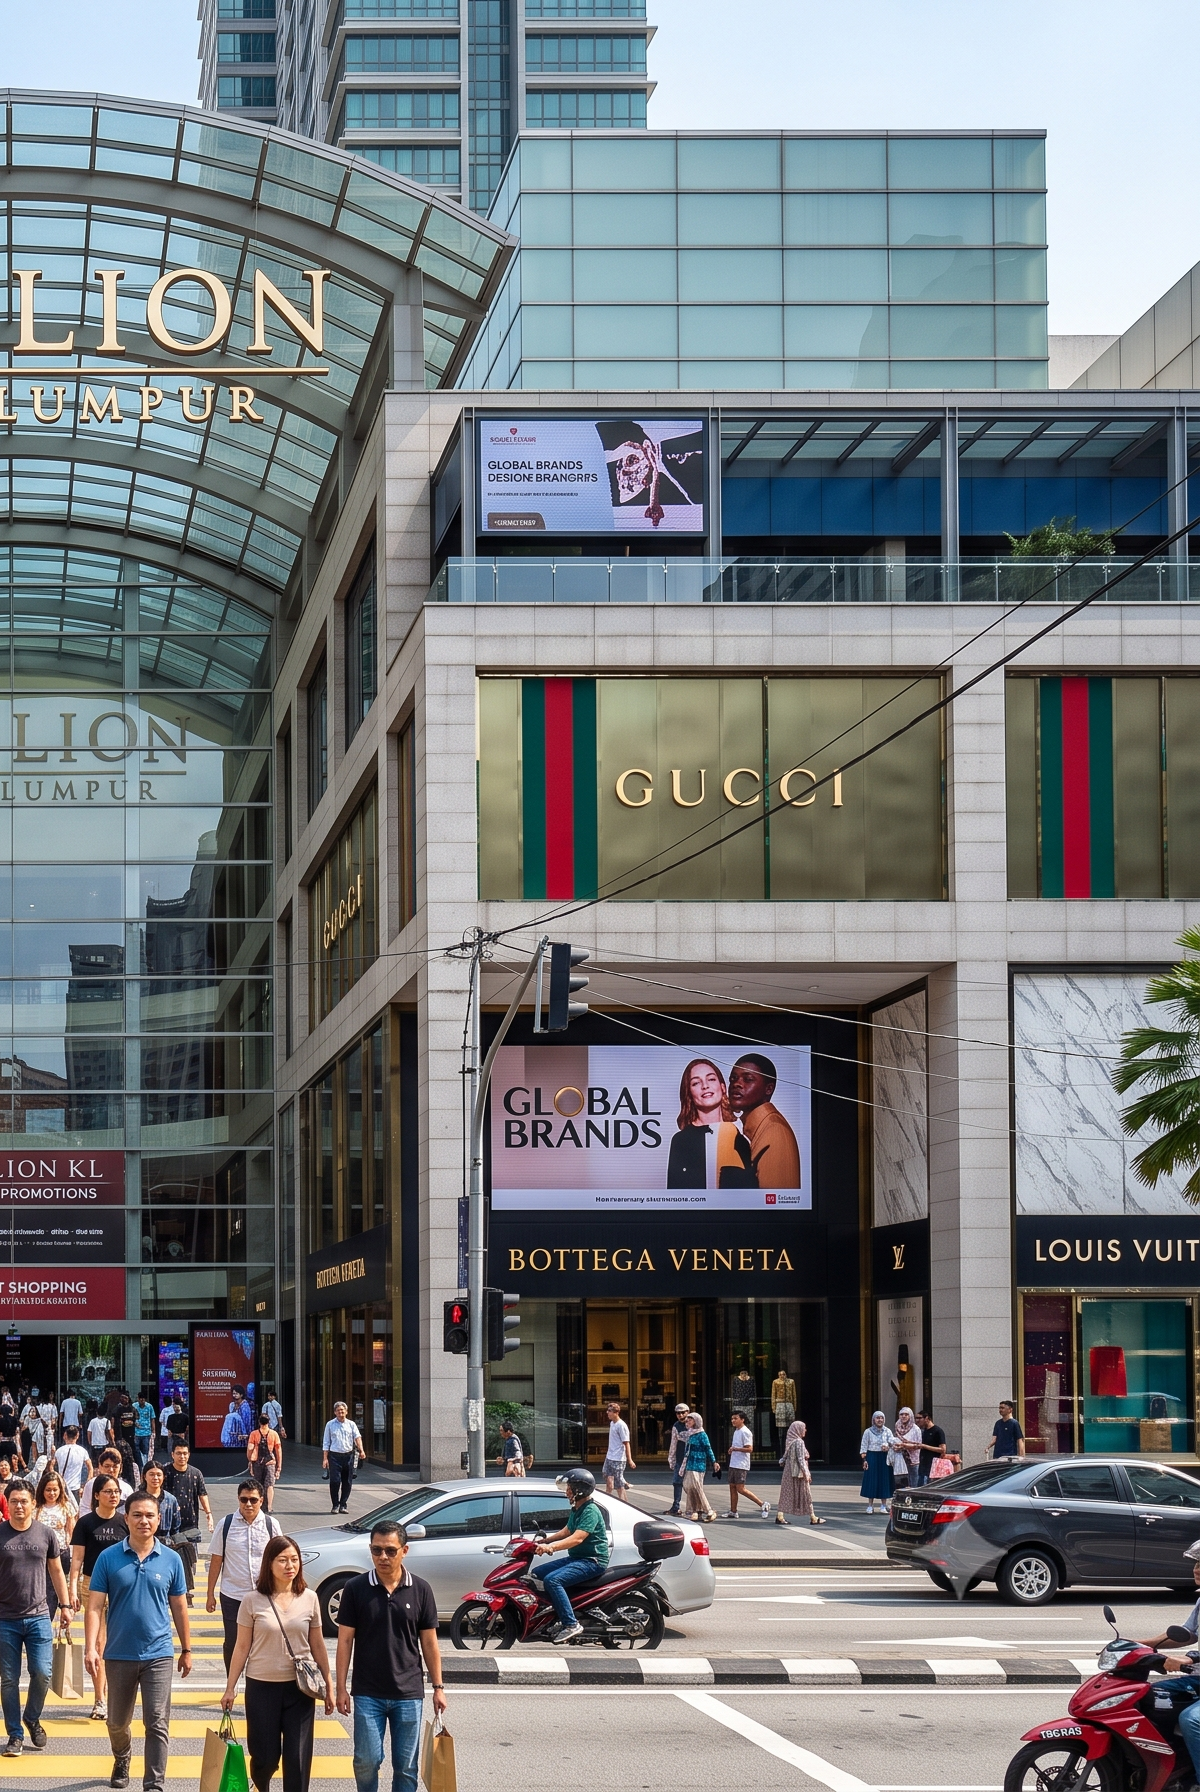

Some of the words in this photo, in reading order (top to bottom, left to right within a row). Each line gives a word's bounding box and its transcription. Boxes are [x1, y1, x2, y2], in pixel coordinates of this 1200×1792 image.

[488, 460, 534, 470] GLOBAL
[536, 460, 583, 470] BRANDS
[615, 767, 843, 808] GUCCI
[503, 1085, 662, 1117] GLOBAL
[504, 1119, 662, 1149] BRANDS
[68, 1159, 104, 1179] KL
[1, 1188, 98, 1199] PROMOTIONS
[508, 1248, 656, 1271] BOTTEGA
[668, 1248, 795, 1271] VENETA
[1035, 1239, 1122, 1263] LOUIS
[8, 1281, 87, 1294] SHOPPING
